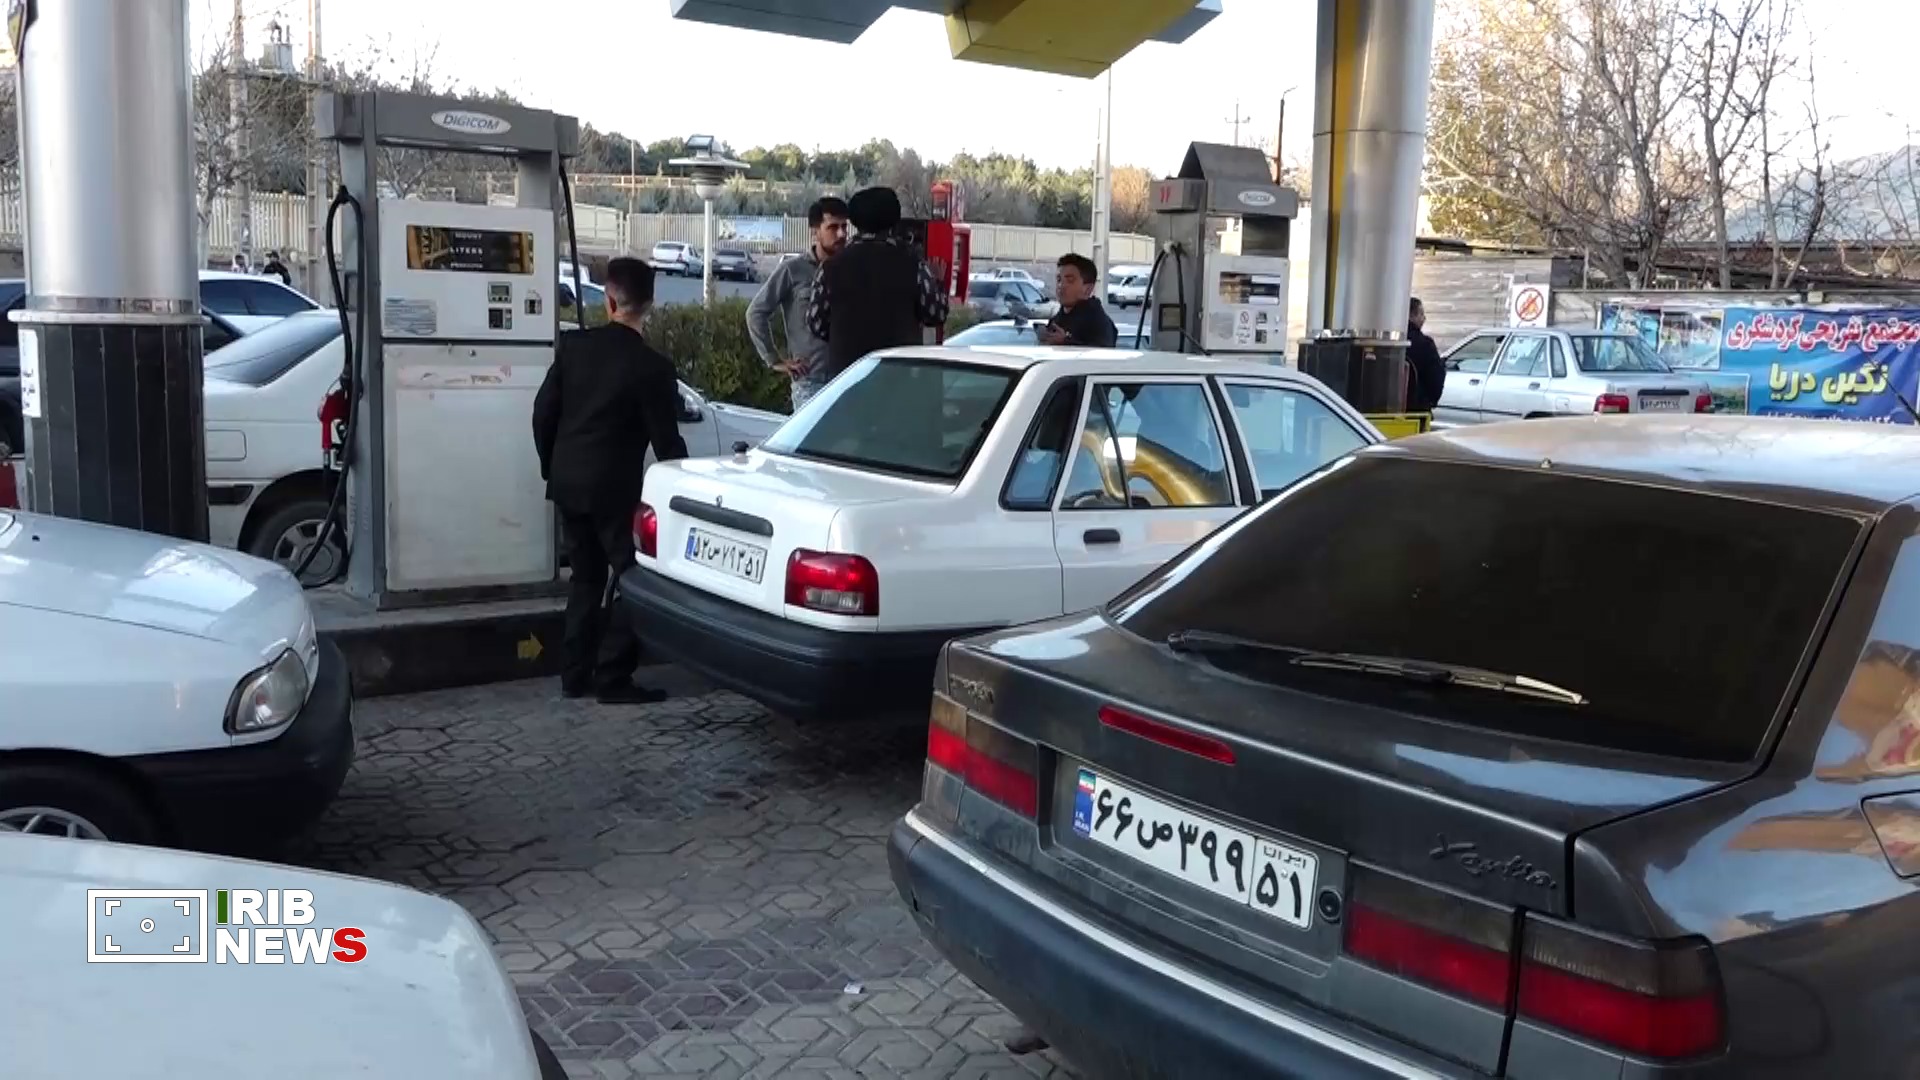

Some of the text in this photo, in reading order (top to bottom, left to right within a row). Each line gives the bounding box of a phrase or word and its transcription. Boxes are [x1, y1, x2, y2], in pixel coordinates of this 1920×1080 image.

[442, 113, 500, 131] DIGICOM
[1797, 315, 1863, 352] تفریحی
[1862, 317, 1920, 352] مجتمع
[1768, 359, 1890, 404] نگین دریا
[1263, 845, 1307, 869] ایران
[1256, 861, 1302, 919] ۵۱
